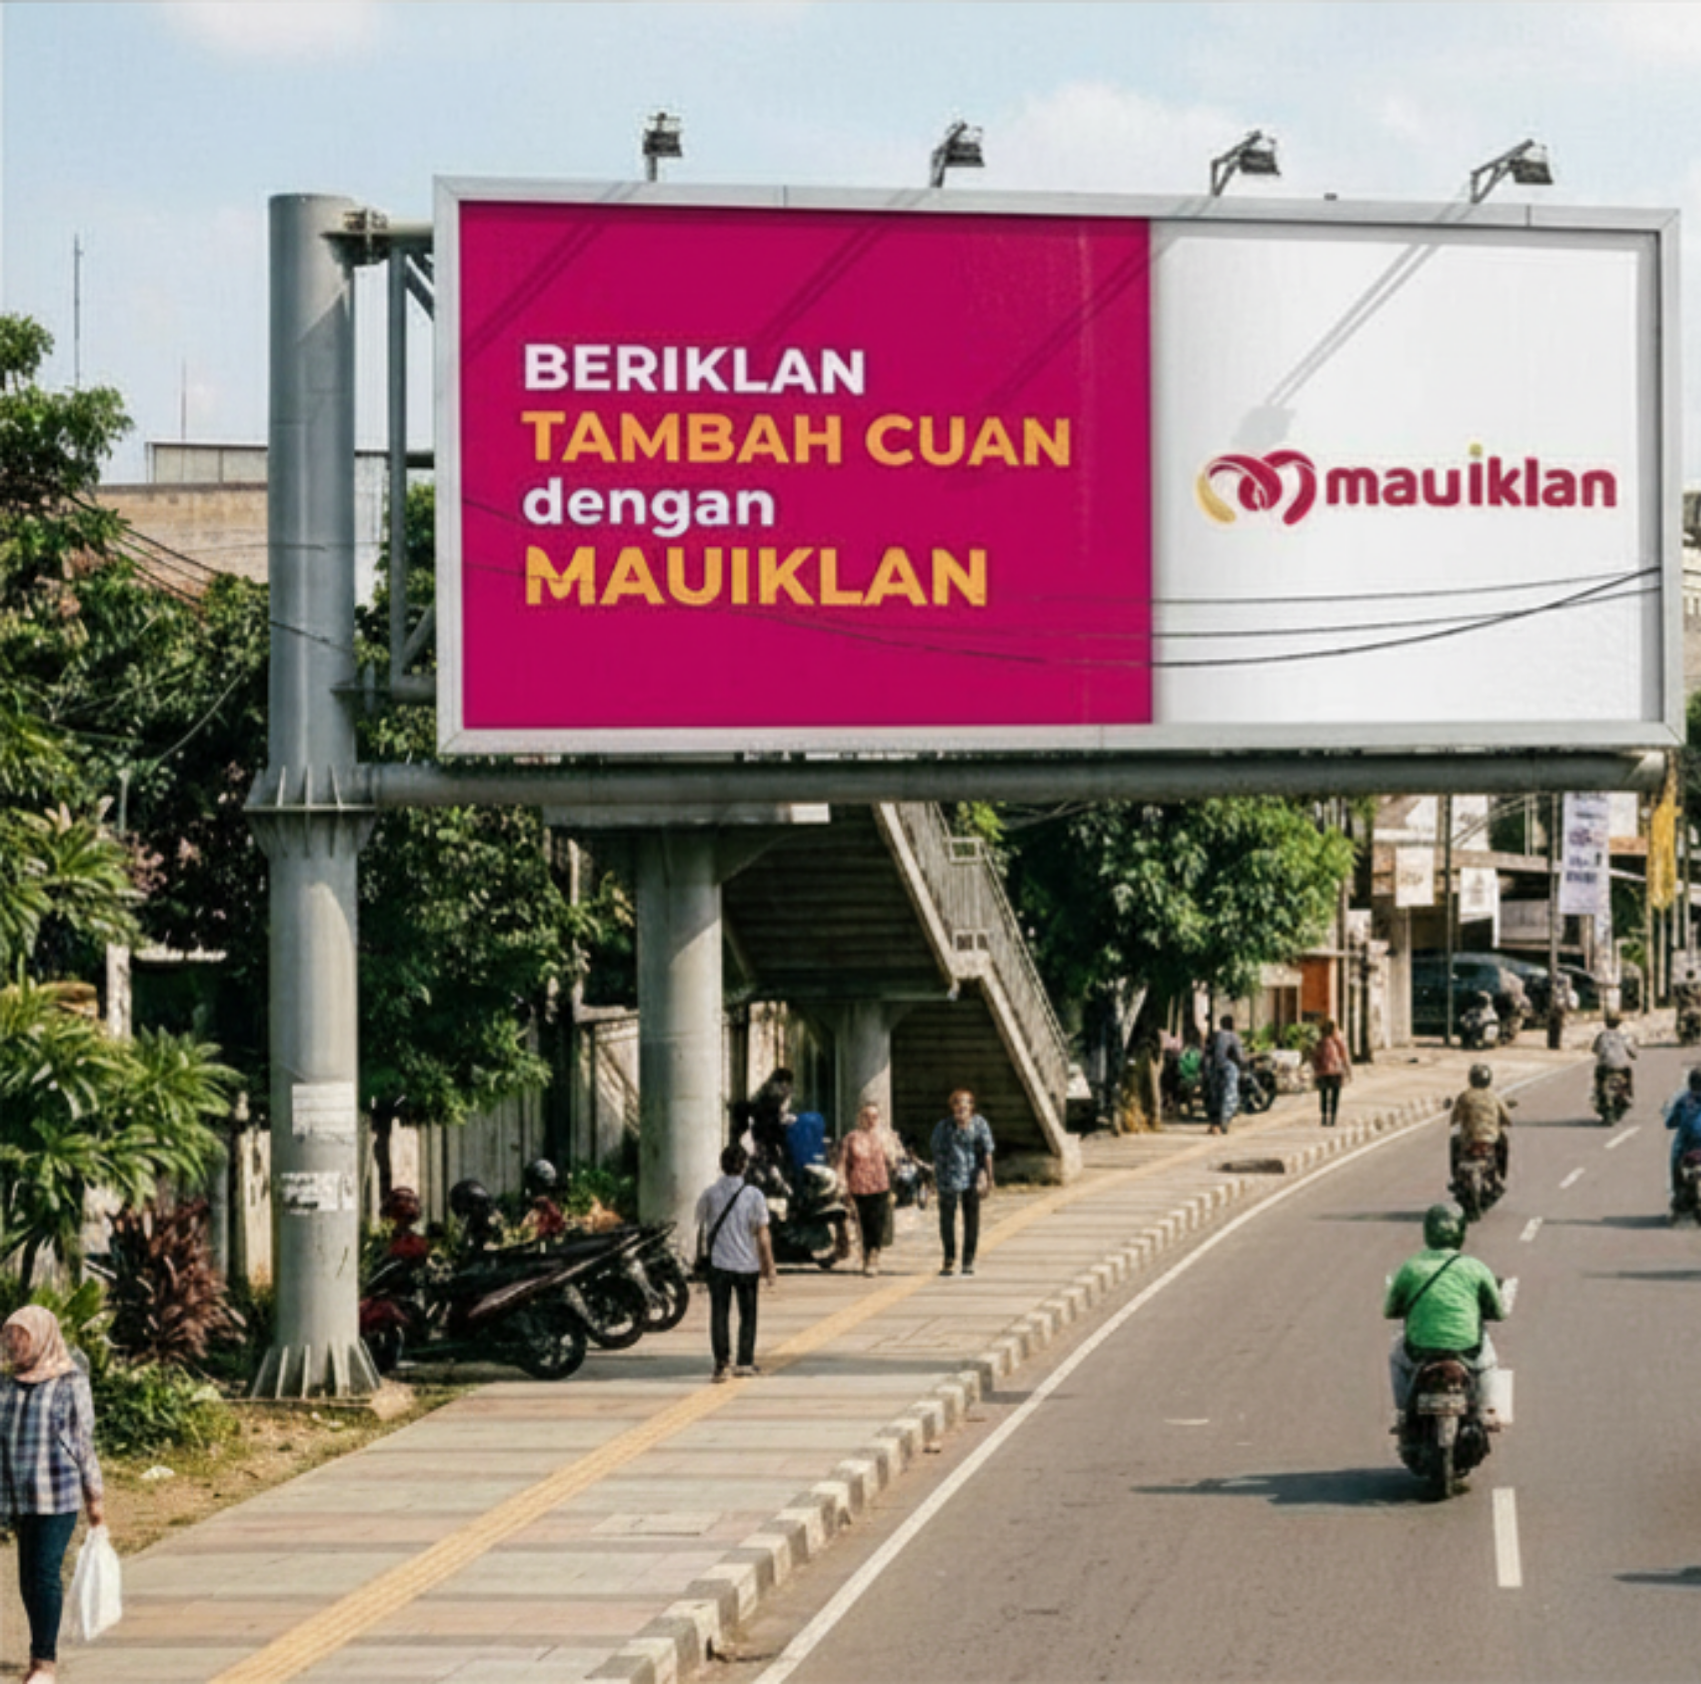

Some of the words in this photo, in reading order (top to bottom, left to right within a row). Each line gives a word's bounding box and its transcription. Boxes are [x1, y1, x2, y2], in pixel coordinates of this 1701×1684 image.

[525, 344, 864, 395] BERIKLAN
[523, 412, 840, 462] TAMBAH
[867, 416, 1069, 465] CUAN
[1326, 444, 1616, 507] mauiklan
[524, 477, 774, 537] dengan
[527, 547, 986, 605] MAUIKLAN
